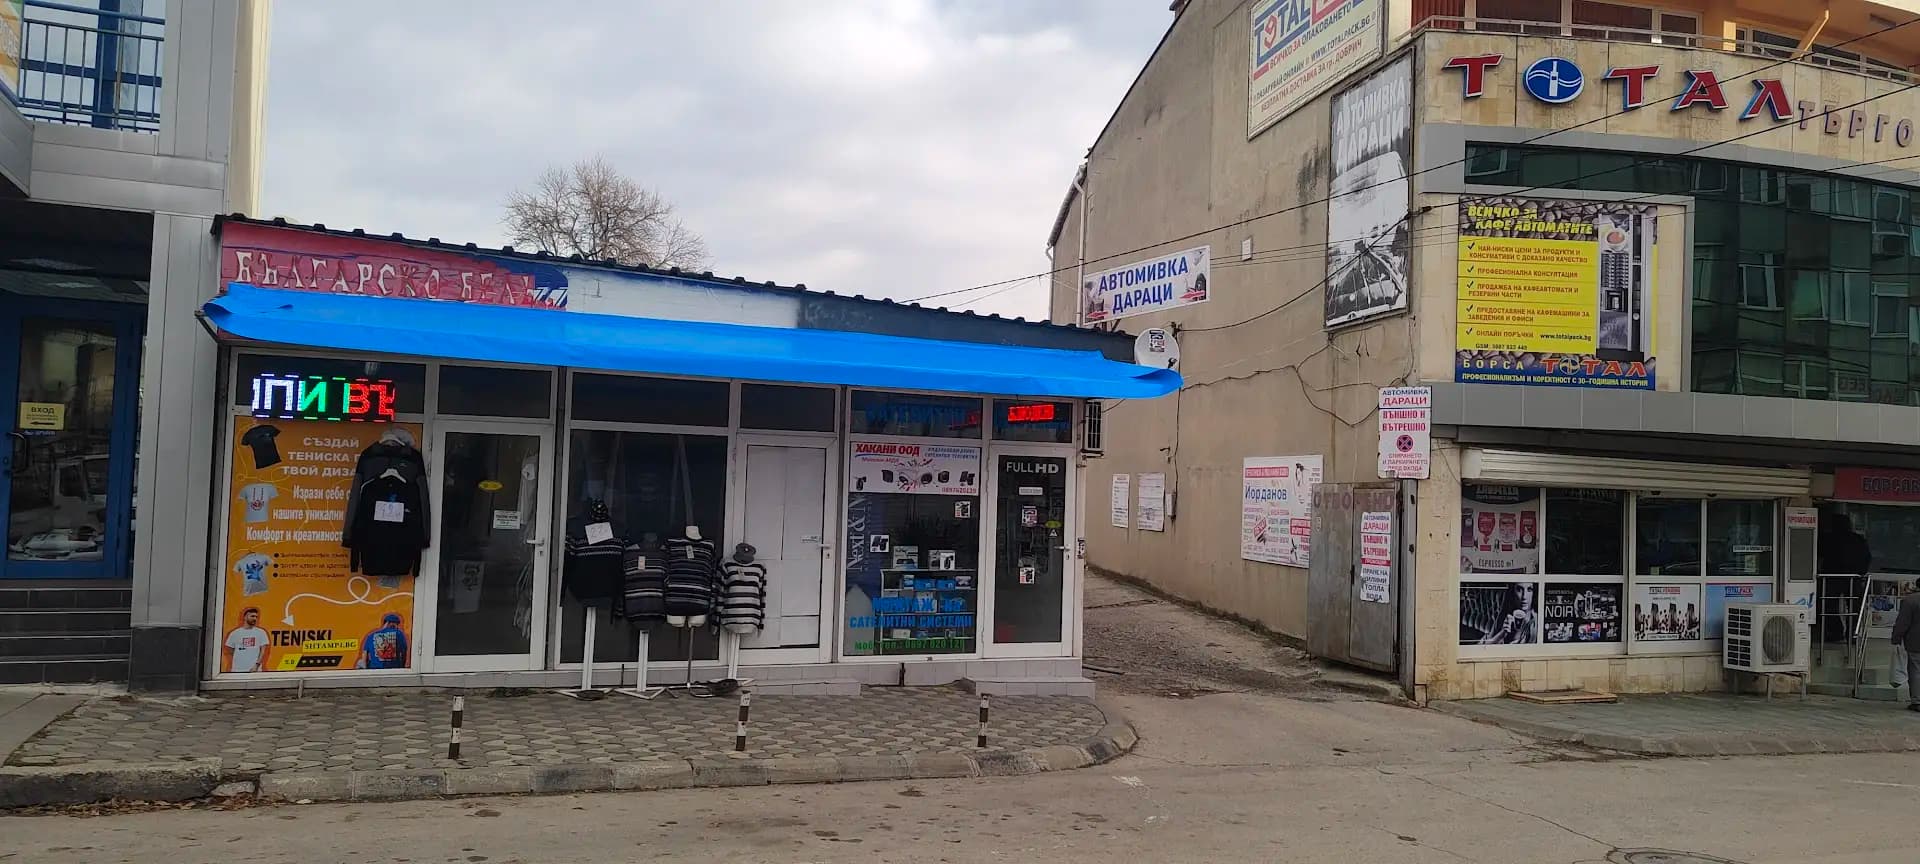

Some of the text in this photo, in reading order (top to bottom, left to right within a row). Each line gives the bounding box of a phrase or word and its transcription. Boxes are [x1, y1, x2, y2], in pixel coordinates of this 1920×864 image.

[1270, 2, 1352, 70] ВСИЧКО ЗА ОПАКОВАНЕТО
[1335, 39, 1362, 65] ДОБРИЧ
[1336, 76, 1405, 137] АВТОМИВКА
[1336, 111, 1404, 175] ДАРАЦИ
[1468, 206, 1539, 220] ВСИЧКО ЗА
[1475, 219, 1593, 235] КАФЕ АВТОМАТИТЕ
[1543, 248, 1575, 256] ПРОДУКТИ
[1470, 252, 1515, 261] КОНСУМАТИВИ
[1555, 256, 1588, 264] КАЧЕСТВО
[1098, 256, 1189, 295] АВТОМИВКА
[1478, 268, 1578, 279] ПРОФЕСИОНАЛНА КОНСУЛТАЦИЯ
[1477, 283, 1513, 291] ПРОДАЖБА
[1112, 282, 1173, 314] ДАРАЦИ
[1501, 291, 1522, 299] ЧАСТИ
[1512, 315, 1534, 323] ОФИСИ
[1503, 331, 1534, 339] ПОРЪЧКИ
[1463, 359, 1524, 370] БОРСА
[1533, 375, 1571, 384] КОРЕКТНОСТ
[1383, 397, 1427, 406] ДАРАЦИ
[1383, 410, 1425, 419] ВЪНШНО И
[1382, 422, 1426, 431] ВЪТРЕШНО
[855, 444, 920, 457] ХАКАНИ ООД
[287, 451, 350, 462] ТЕНИСКА
[283, 465, 319, 475] ТВОЙ
[1006, 462, 1059, 474] FULL HD
[293, 484, 324, 500] Изрази
[325, 486, 344, 500] себе
[305, 510, 344, 523] уникални
[1363, 523, 1388, 531] ДАРАЦИ
[247, 527, 284, 543] Комфорт
[1478, 559, 1505, 568] ESPRESSO
[1365, 584, 1385, 592] ТОПЛА
[1366, 593, 1383, 601] ВОДА
[1545, 605, 1574, 618] NOIR
[849, 615, 972, 628] САТЕЛИТНИ СИСТЕМИ
[272, 629, 332, 646] TENISKI
